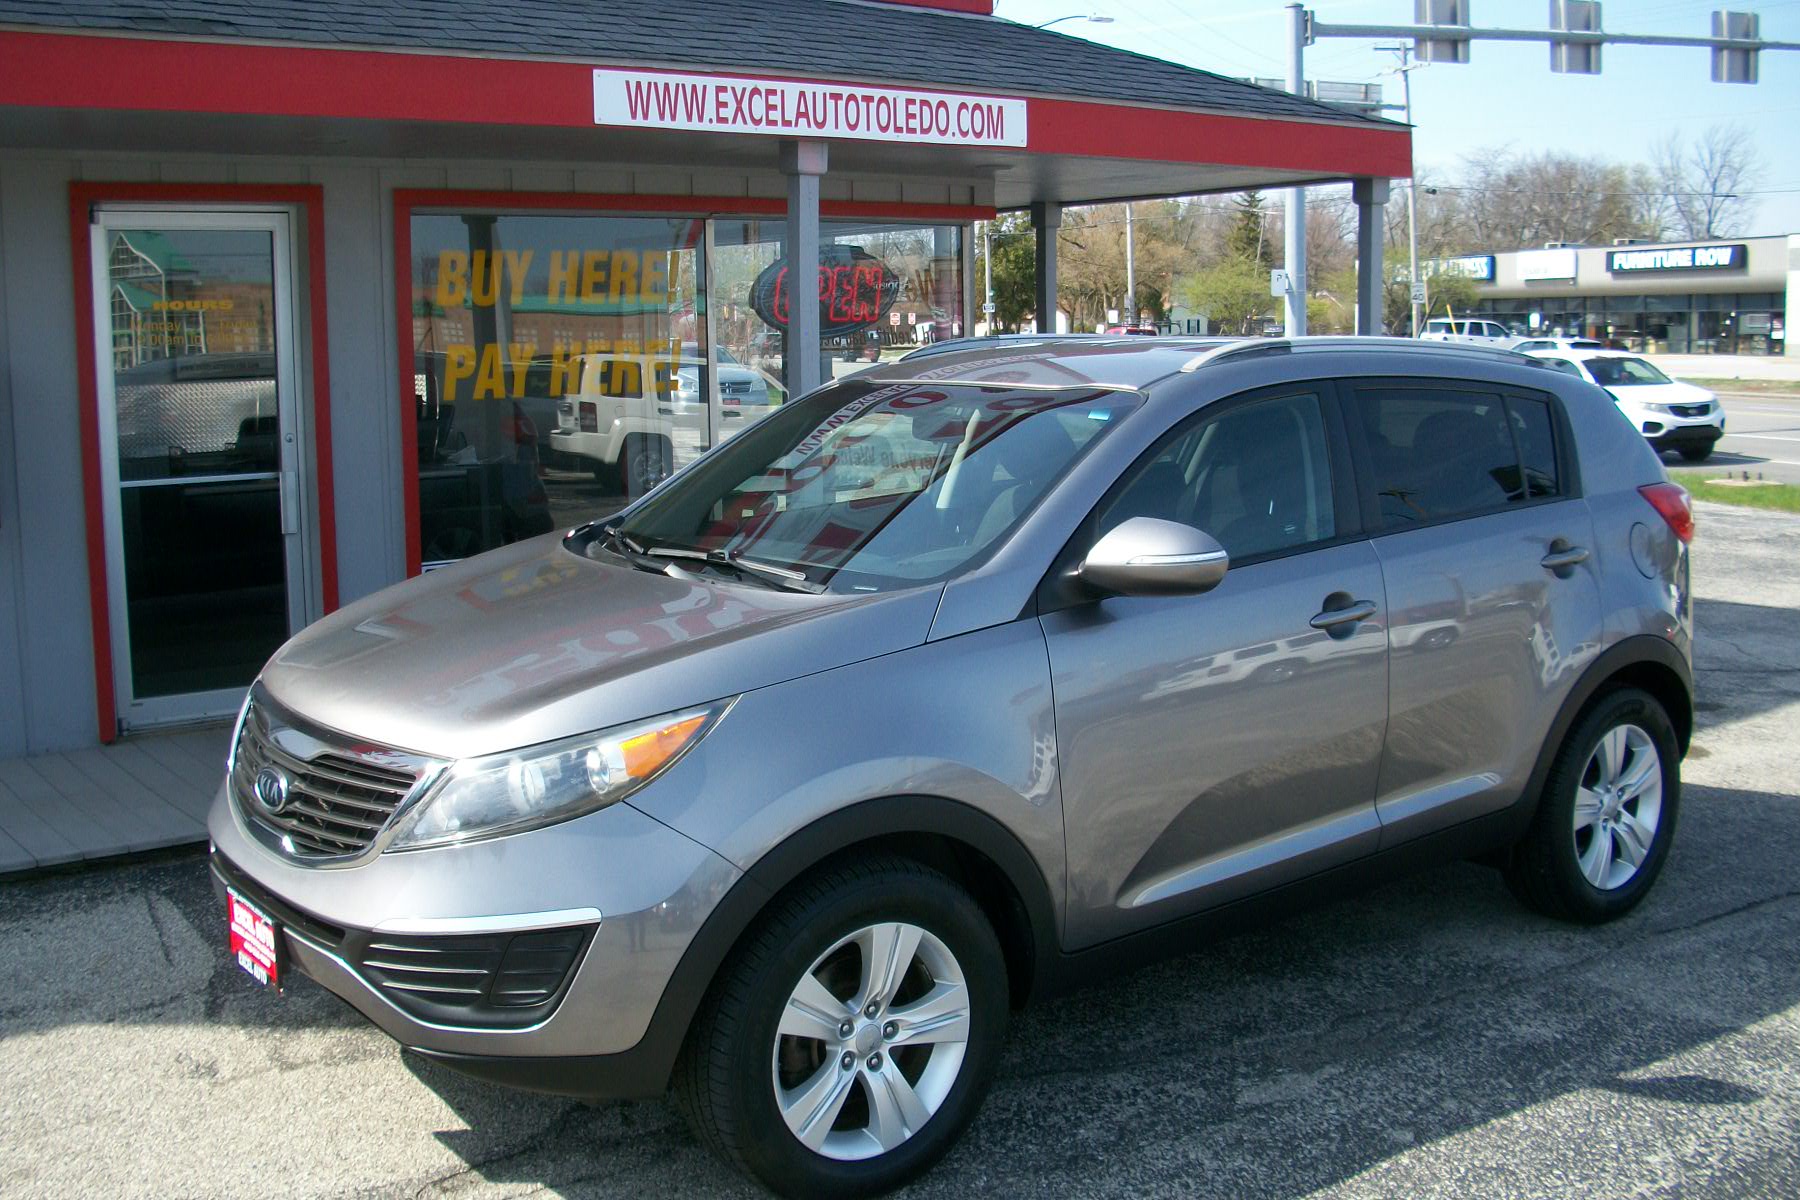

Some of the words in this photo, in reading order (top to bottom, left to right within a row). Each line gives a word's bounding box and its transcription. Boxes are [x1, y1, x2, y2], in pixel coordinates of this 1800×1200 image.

[624, 79, 1005, 140] WWW.EXCELAUTOTOLEDO.COM
[1613, 249, 1693, 269] FURNITURE
[1695, 247, 1732, 266] ROW
[436, 248, 534, 309] BUY
[547, 248, 681, 305] HERE!
[152, 299, 234, 311] HOURS
[1411, 293, 1424, 302] 40
[443, 341, 539, 401] PAY
[259, 774, 279, 805] KIA
